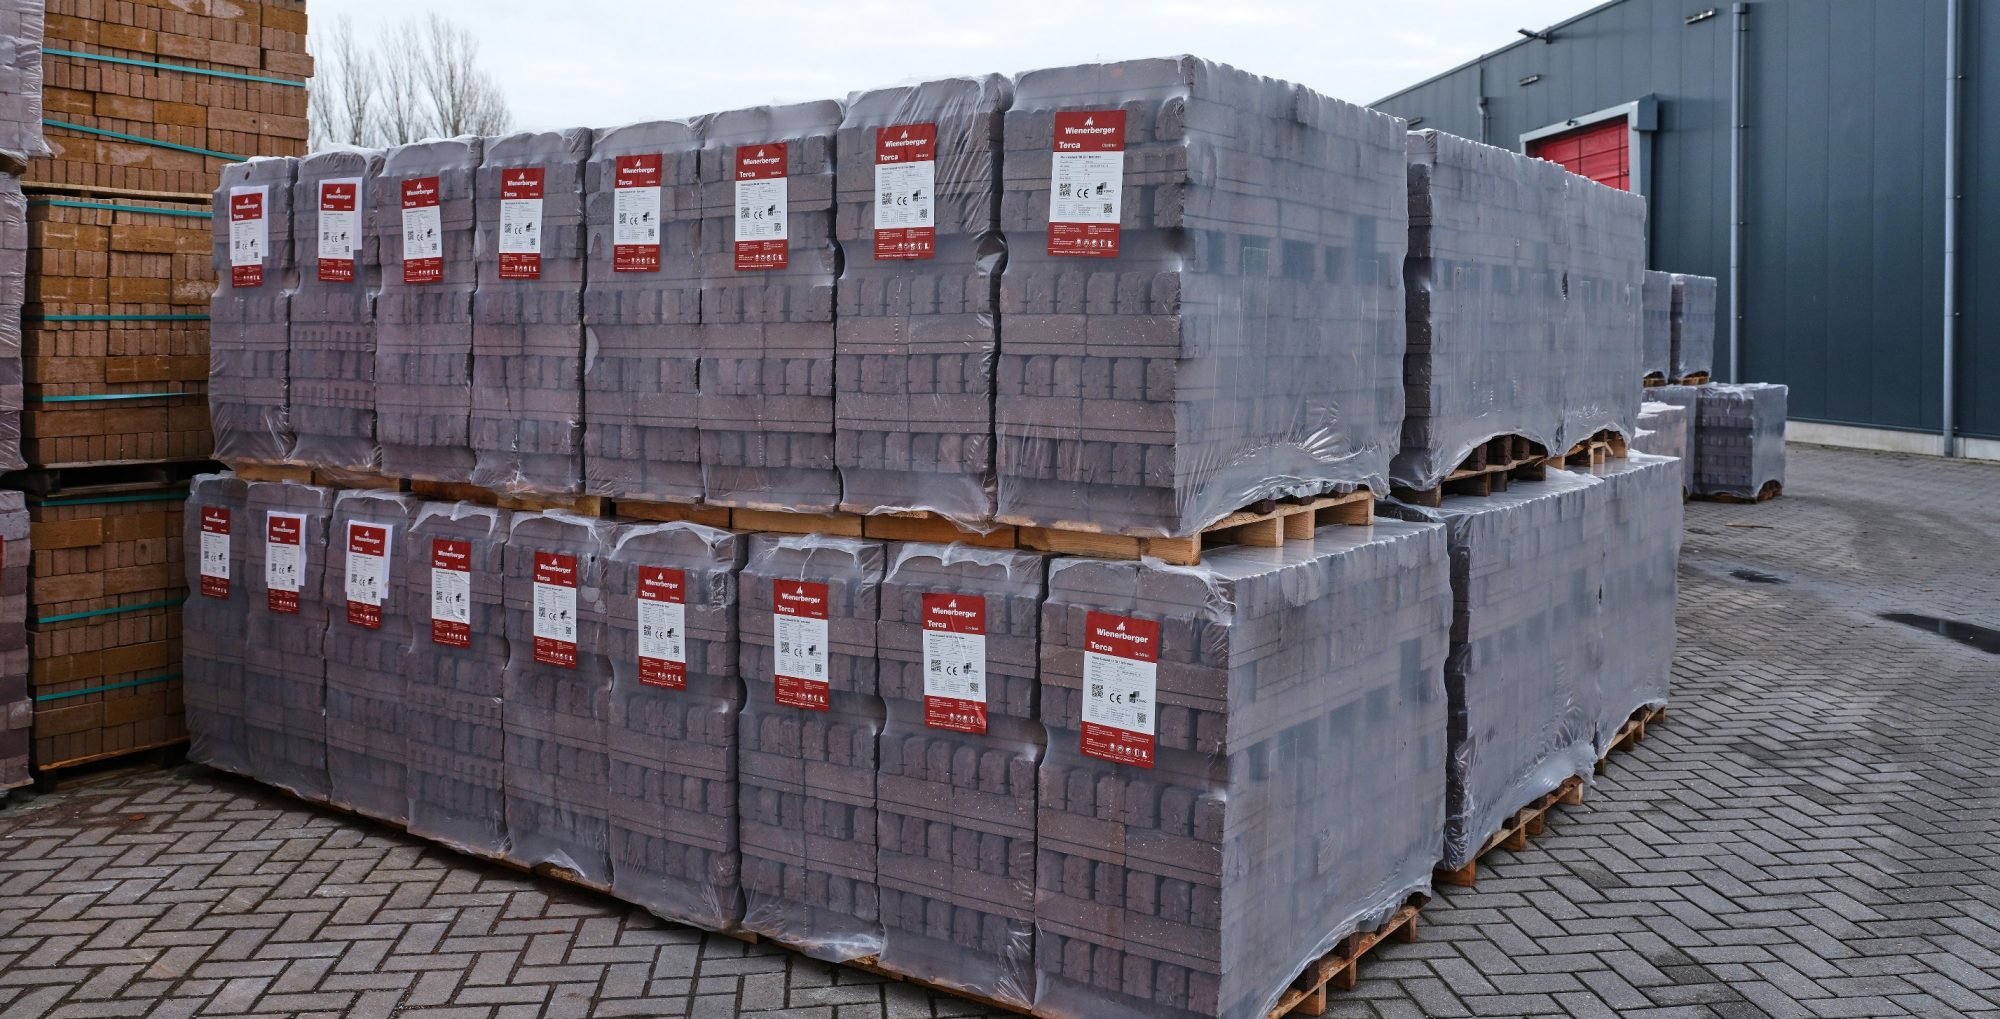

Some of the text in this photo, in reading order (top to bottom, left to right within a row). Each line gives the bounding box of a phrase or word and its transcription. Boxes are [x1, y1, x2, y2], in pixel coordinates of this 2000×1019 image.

[1065, 127, 1116, 135] Wienerberger
[885, 139, 927, 147] Wienerberger
[1059, 141, 1081, 149] Terca
[645, 578, 678, 589] Wienerberger
[782, 593, 820, 604] Wienerberger
[778, 604, 794, 613] Terca
[932, 606, 976, 618] Wienerberger
[928, 620, 946, 628] Terca
[1096, 628, 1149, 644] Wienerberger
[1091, 641, 1112, 652] Terca
